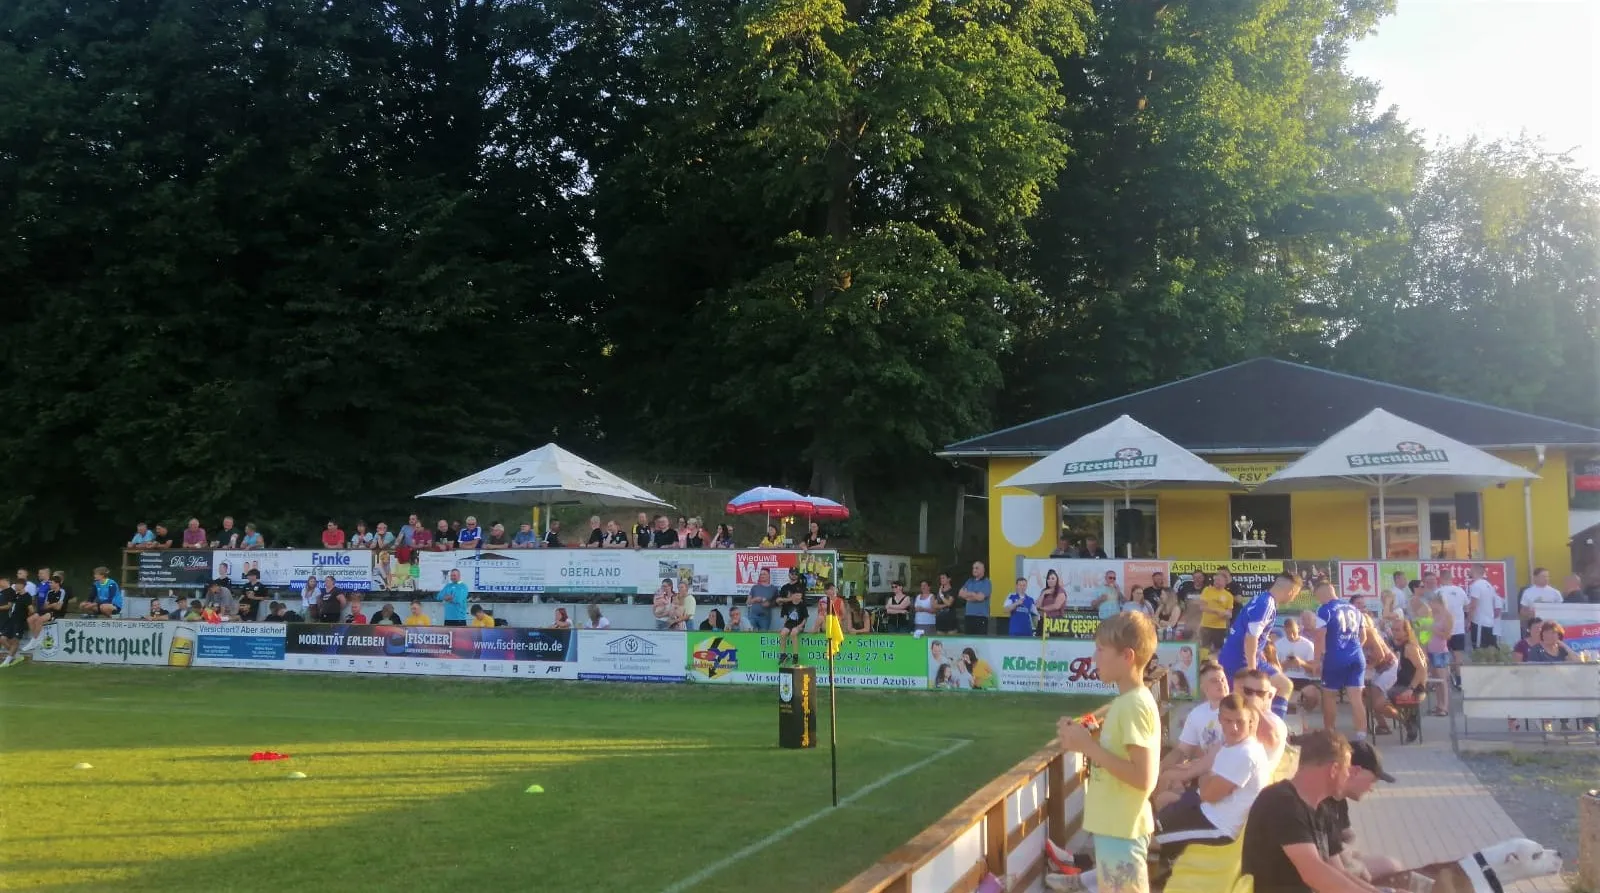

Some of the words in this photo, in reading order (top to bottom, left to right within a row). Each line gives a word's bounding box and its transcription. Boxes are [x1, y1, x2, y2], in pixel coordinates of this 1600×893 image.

[1350, 450, 1445, 466] Sternquell
[1066, 456, 1155, 474] Sternquell
[1239, 472, 1262, 482] FSV
[312, 552, 350, 565] Funke
[738, 554, 777, 562] Wieduwilt
[294, 568, 311, 576] Kran-
[560, 567, 621, 577] OBERLAND
[1232, 562, 1266, 571] Schleiz
[199, 625, 239, 634] Versichert?
[241, 625, 258, 634] Aber
[1044, 617, 1069, 632] PLATZ
[63, 628, 163, 661] Sternquell
[299, 632, 344, 645] MOBILITÄT
[347, 636, 384, 647] ERLEBEN
[474, 639, 562, 653] www.fischer-auto.de
[857, 639, 894, 649] Schleiz
[866, 653, 877, 661] 27
[884, 653, 894, 661] 14
[1003, 656, 1068, 671] Küchen
[746, 674, 762, 682] Wir
[883, 678, 917, 687] Azubis
